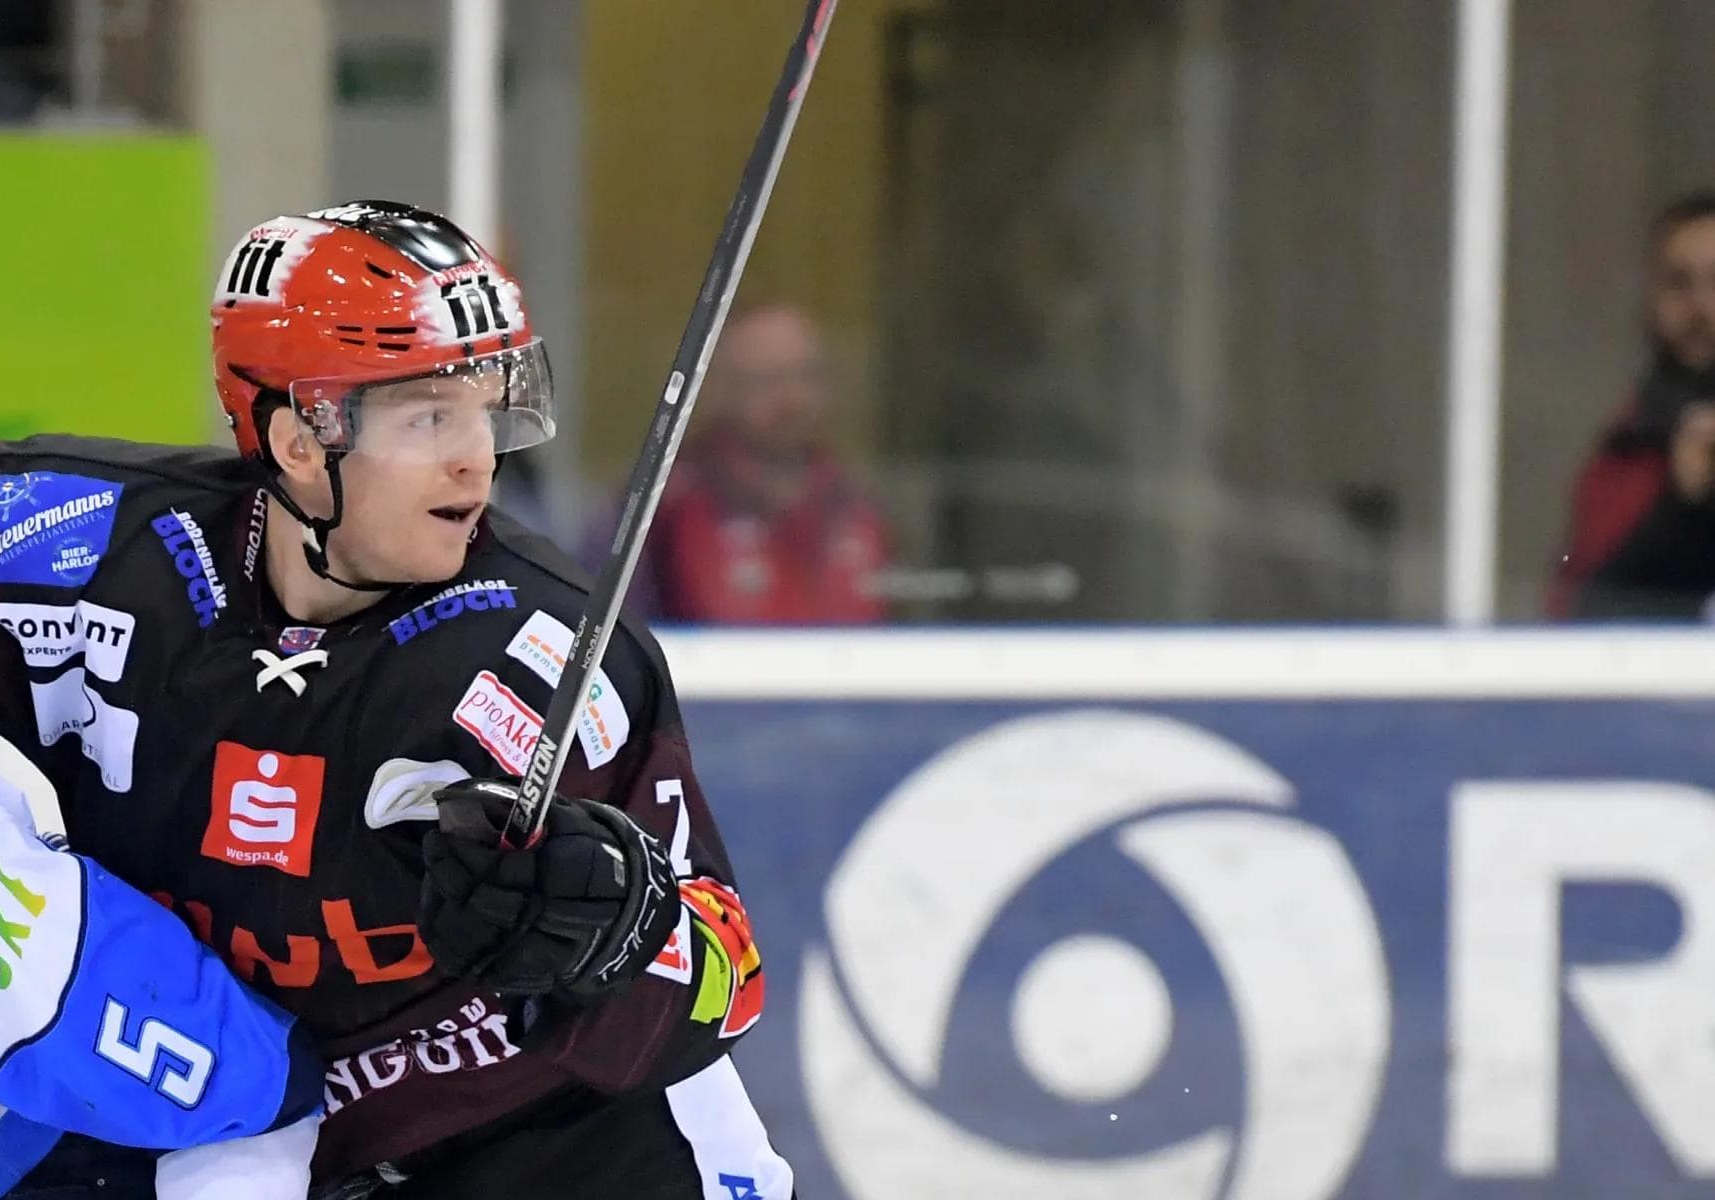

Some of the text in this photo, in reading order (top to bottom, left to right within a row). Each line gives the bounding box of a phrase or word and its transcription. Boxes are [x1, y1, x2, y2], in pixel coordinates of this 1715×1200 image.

[227, 238, 287, 297] fit
[440, 274, 510, 339] fit
[175, 510, 228, 610] BODENBELÄG
[388, 588, 518, 646] BLOCH
[512, 732, 558, 834] EASTON
[225, 845, 289, 867] wespa.de
[655, 778, 693, 877] 7
[91, 993, 216, 1108] 5
